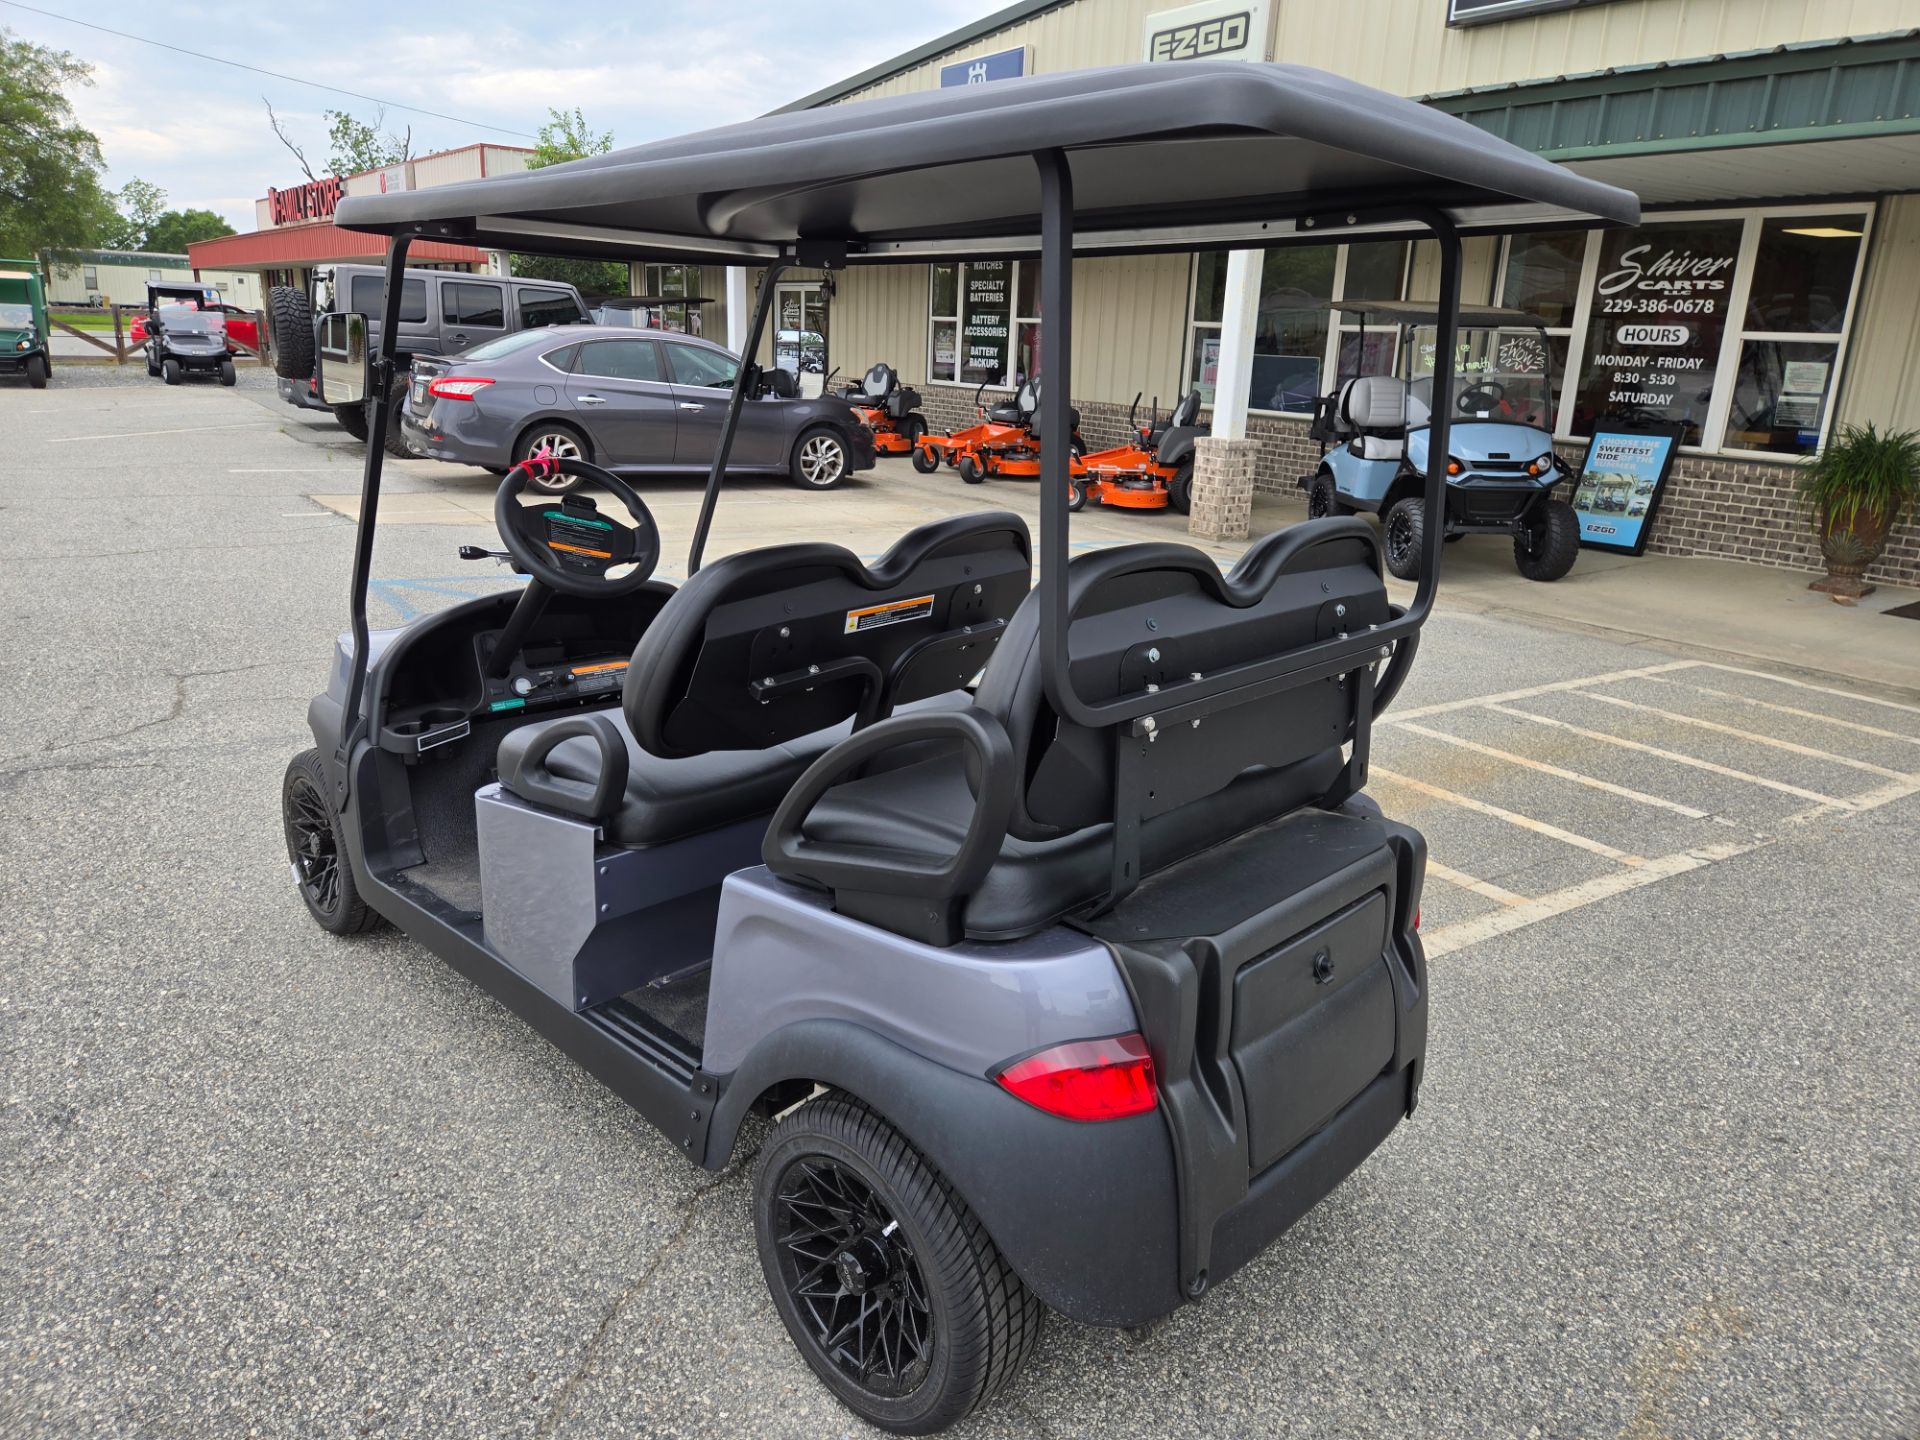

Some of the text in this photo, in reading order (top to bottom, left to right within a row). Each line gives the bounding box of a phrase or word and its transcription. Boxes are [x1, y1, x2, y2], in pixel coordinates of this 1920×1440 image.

[1151, 13, 1248, 61] EZGO
[274, 185, 307, 222] FAMILY
[1598, 244, 1733, 295] Shiver
[970, 280, 1004, 290] SPECIALTY
[1637, 280, 1725, 290] CARTS
[970, 292, 1004, 302] BATTERIES
[1603, 299, 1714, 313] 229-386-0678
[972, 314, 1000, 325] BATTERY
[964, 326, 1007, 337] ACCESSORIES
[1624, 328, 1681, 342] HOURS
[970, 346, 998, 357] BATTERY
[969, 358, 999, 368] BACKUPS
[1594, 355, 1649, 368] MONDAY
[1657, 357, 1704, 370] FRIDAY
[1613, 372, 1640, 383] 8:30
[1648, 374, 1675, 385] 5:30
[1608, 391, 1673, 405] SATURDAY
[1599, 445, 1651, 455] SWEETEST
[1596, 452, 1620, 460] RIDE
[1586, 525, 1616, 534] EZGO
